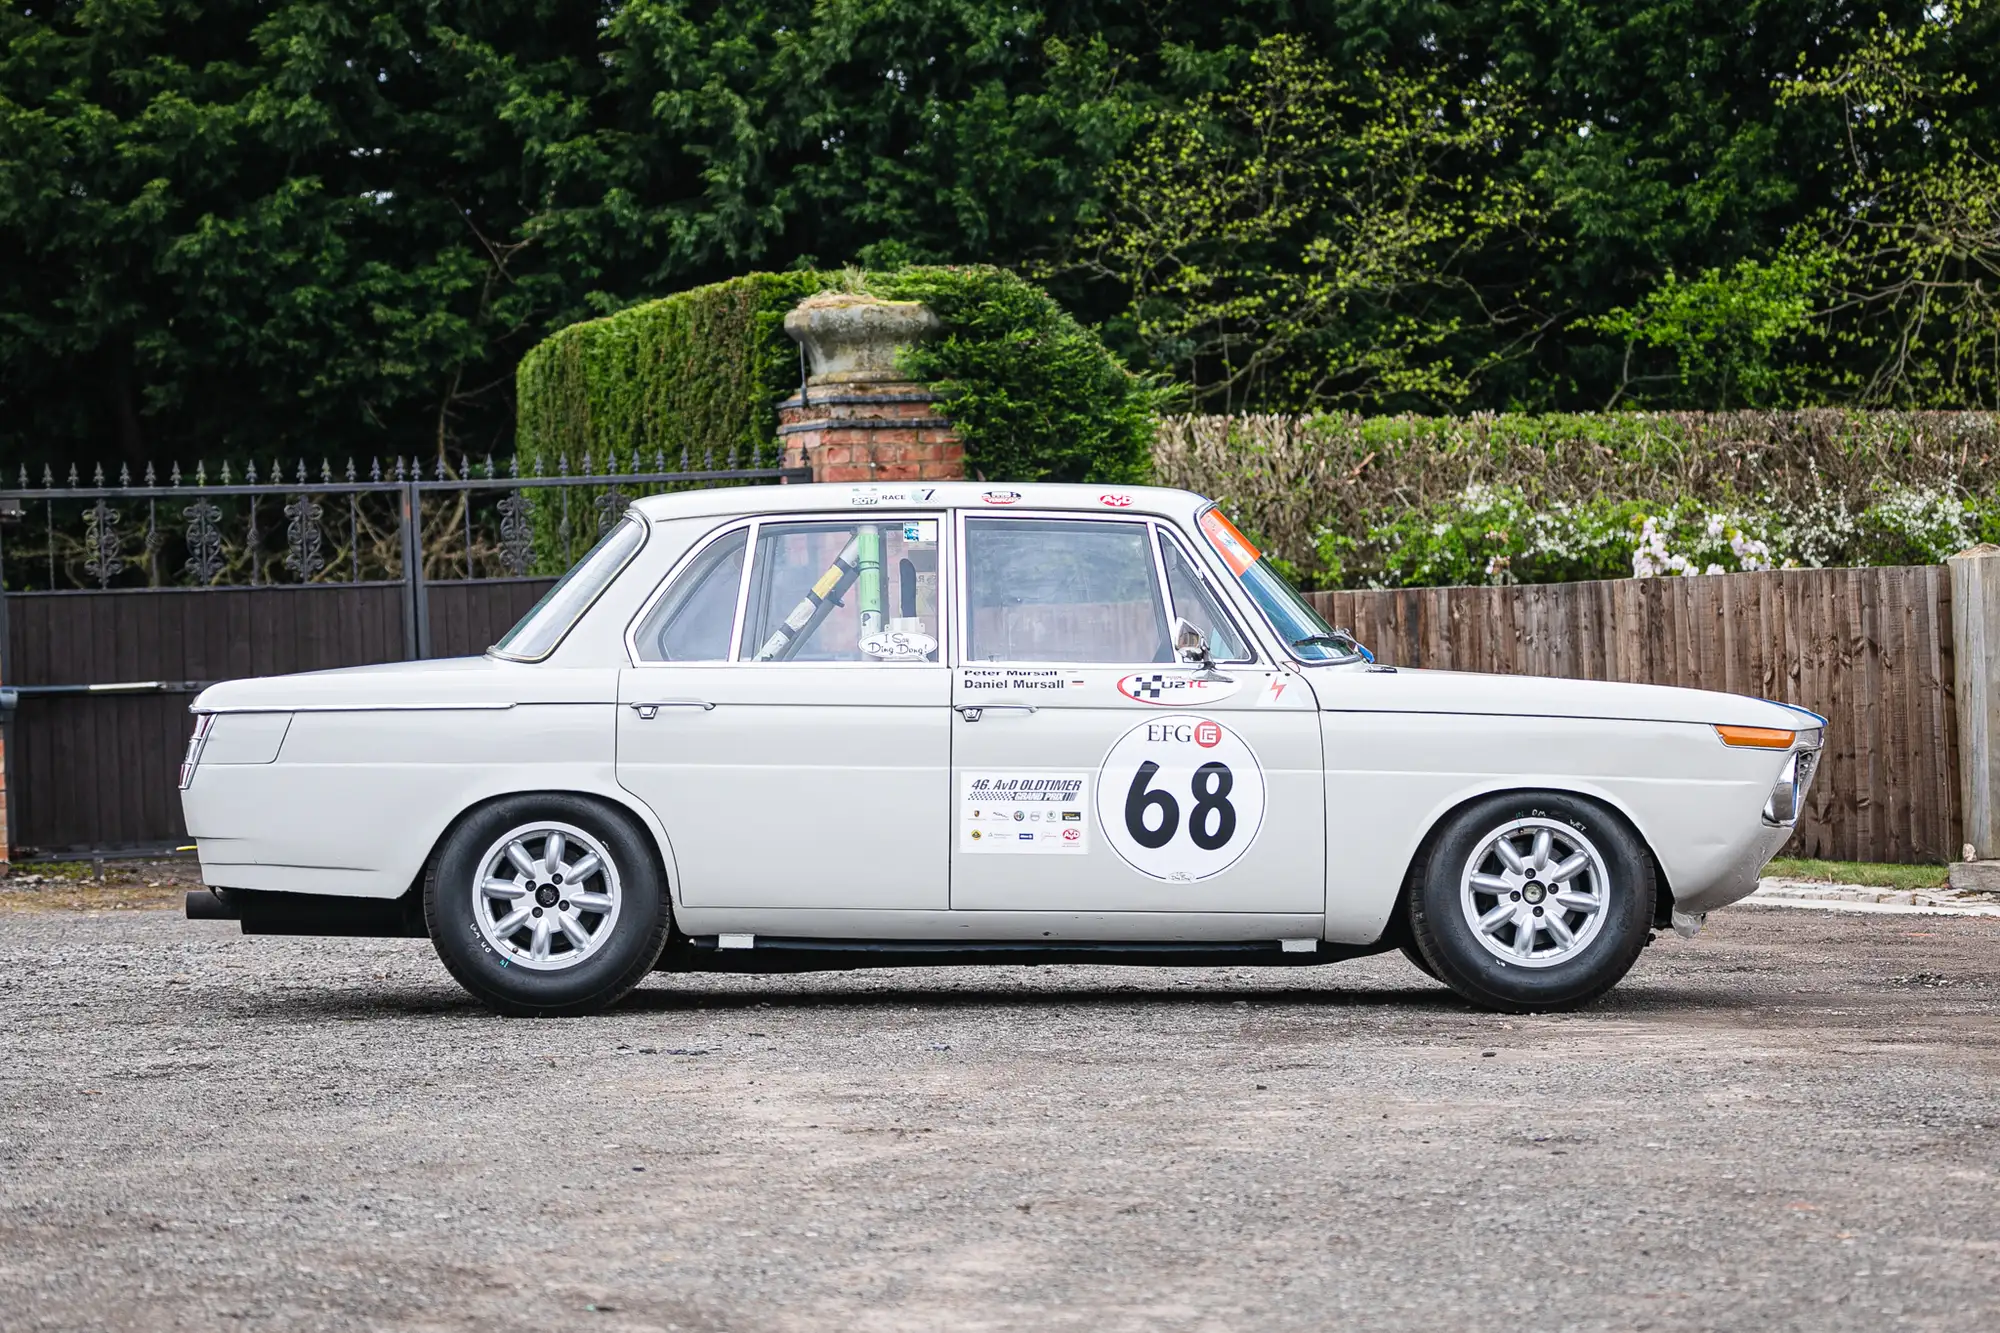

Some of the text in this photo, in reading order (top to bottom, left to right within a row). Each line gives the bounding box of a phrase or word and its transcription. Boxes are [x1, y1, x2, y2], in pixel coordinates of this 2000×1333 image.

[852, 497, 878, 505] 2017
[921, 488, 936, 501] 7
[892, 633, 910, 645] Say
[867, 642, 928, 656] Ding Dong!
[964, 679, 1065, 690] Daniel Mursall
[1161, 680, 1208, 689] U2TC
[1147, 724, 1192, 743] EFG
[971, 779, 991, 790] 46.
[1020, 779, 1083, 791] OLDTIMER
[1015, 792, 1065, 801] GRAND PRIX
[1124, 760, 1237, 851] 68
[1569, 819, 1587, 831] WET
